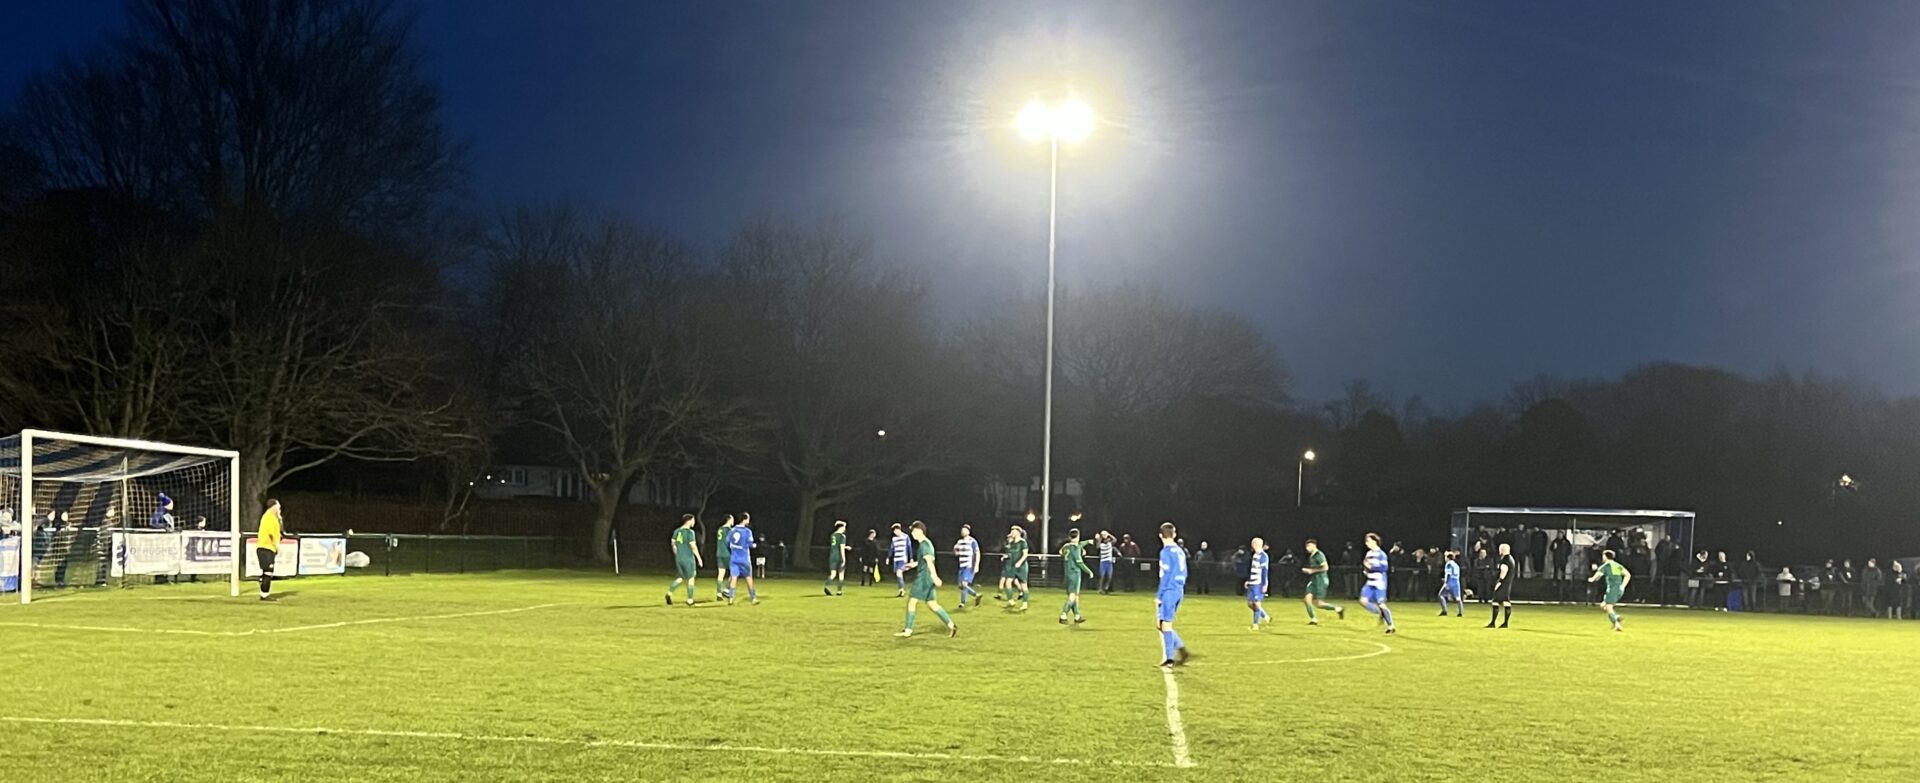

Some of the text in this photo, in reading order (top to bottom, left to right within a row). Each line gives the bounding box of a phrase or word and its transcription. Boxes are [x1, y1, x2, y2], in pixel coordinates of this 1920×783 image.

[676, 532, 683, 544] 4
[733, 532, 741, 543] 9
[831, 536, 837, 546] 3
